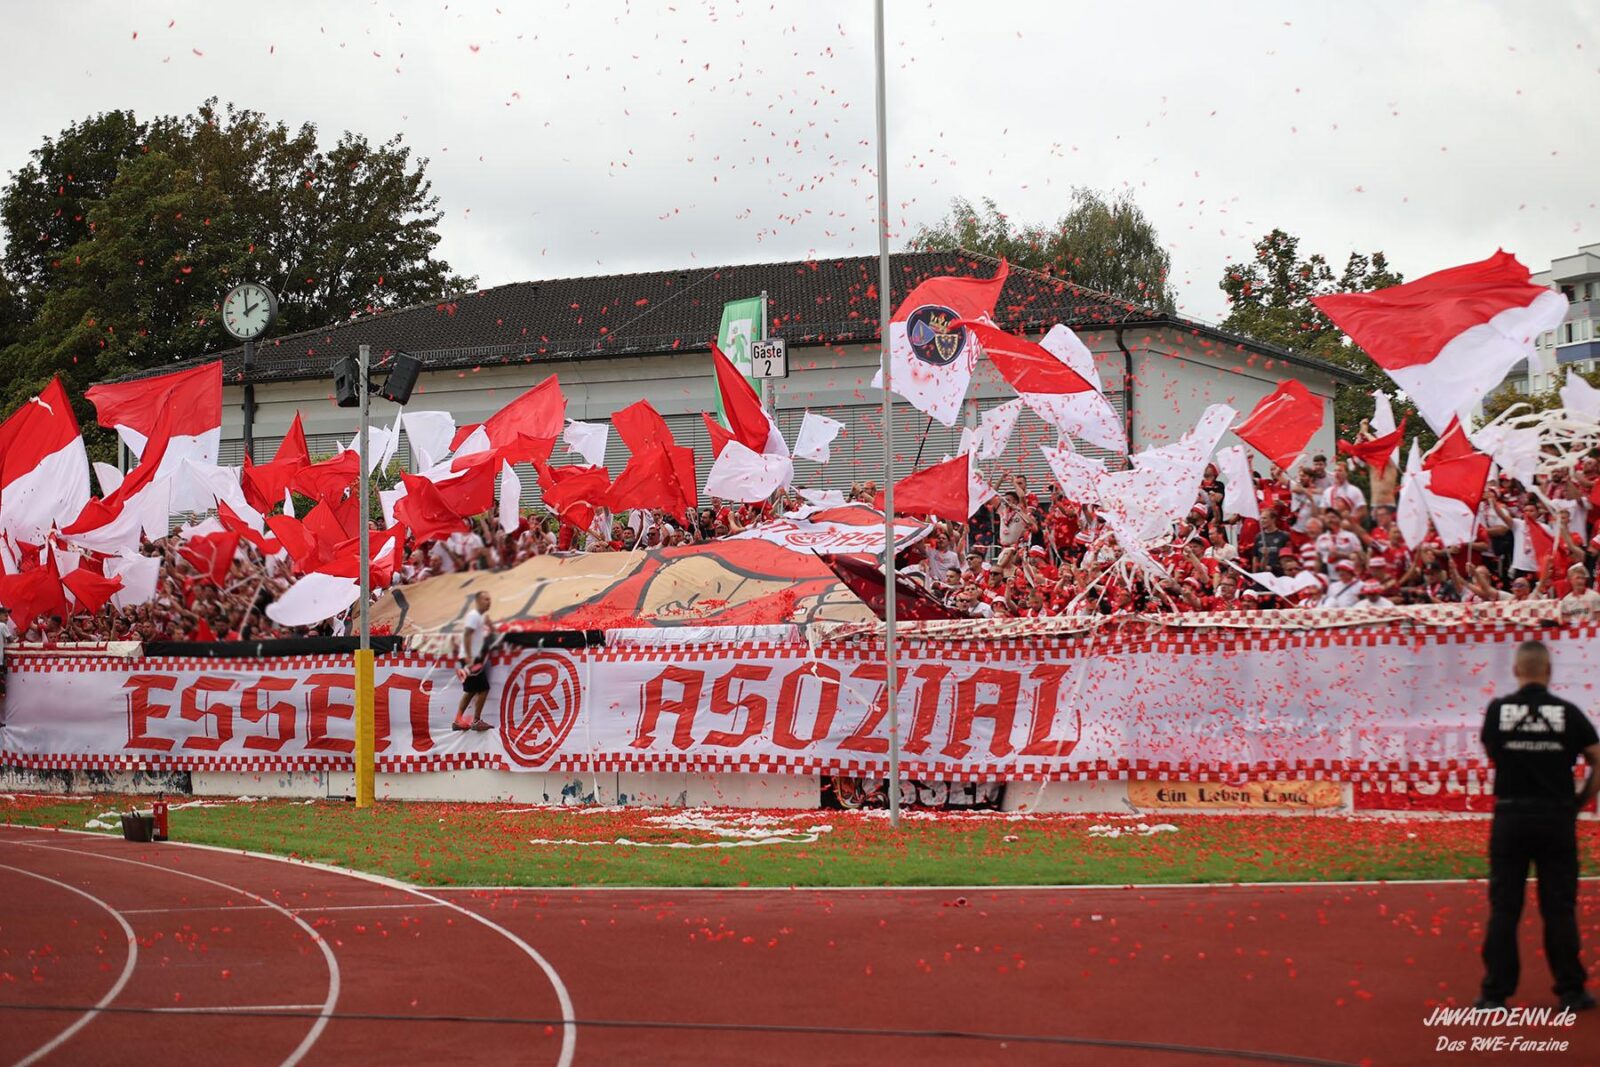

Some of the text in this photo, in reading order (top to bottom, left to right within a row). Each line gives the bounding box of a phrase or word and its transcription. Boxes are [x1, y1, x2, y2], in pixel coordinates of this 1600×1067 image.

[753, 344, 782, 359] Gäste
[764, 359, 772, 376] 2
[123, 673, 433, 753] ESSEN
[629, 663, 1081, 760] ASOZIAL
[1156, 788, 1187, 802] Ein
